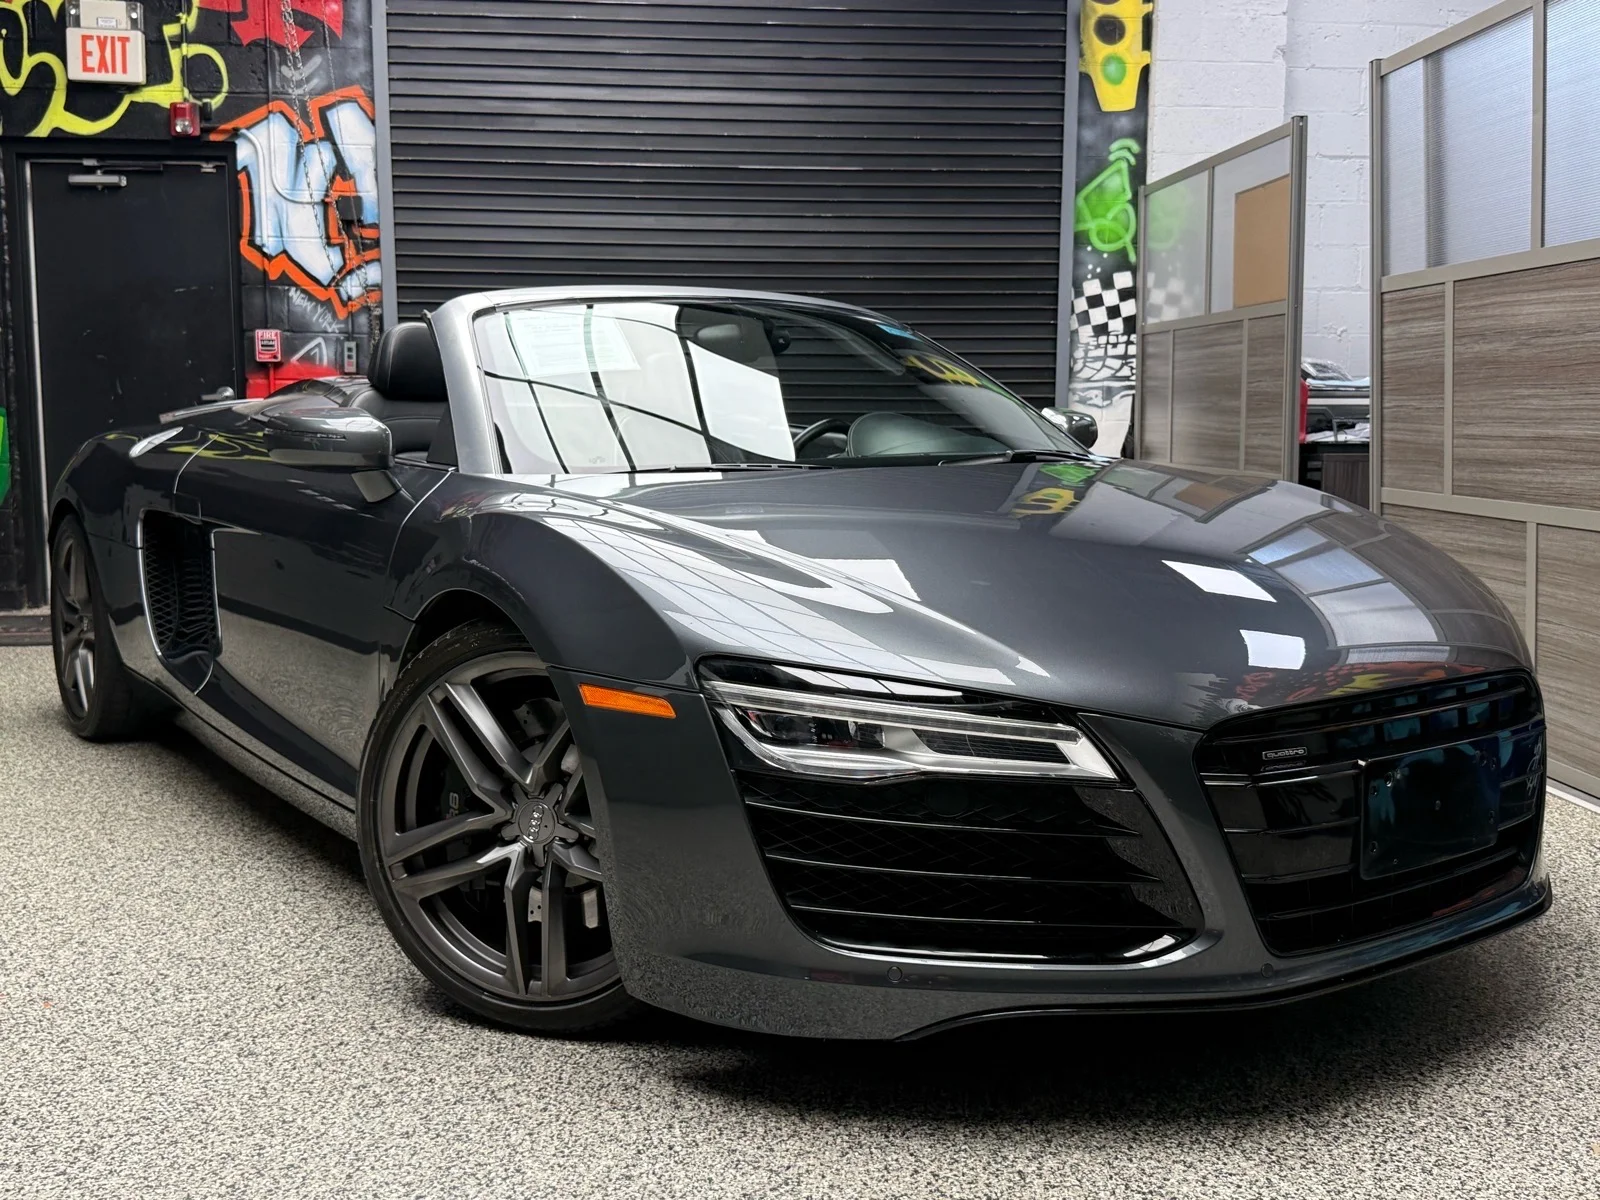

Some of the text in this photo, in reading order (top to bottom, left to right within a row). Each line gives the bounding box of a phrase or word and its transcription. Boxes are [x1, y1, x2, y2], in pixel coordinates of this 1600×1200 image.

[81, 34, 130, 75] EXIT
[289, 287, 345, 333] NEW YORK
[258, 331, 277, 339] FIRE
[1266, 749, 1305, 758] quattro
